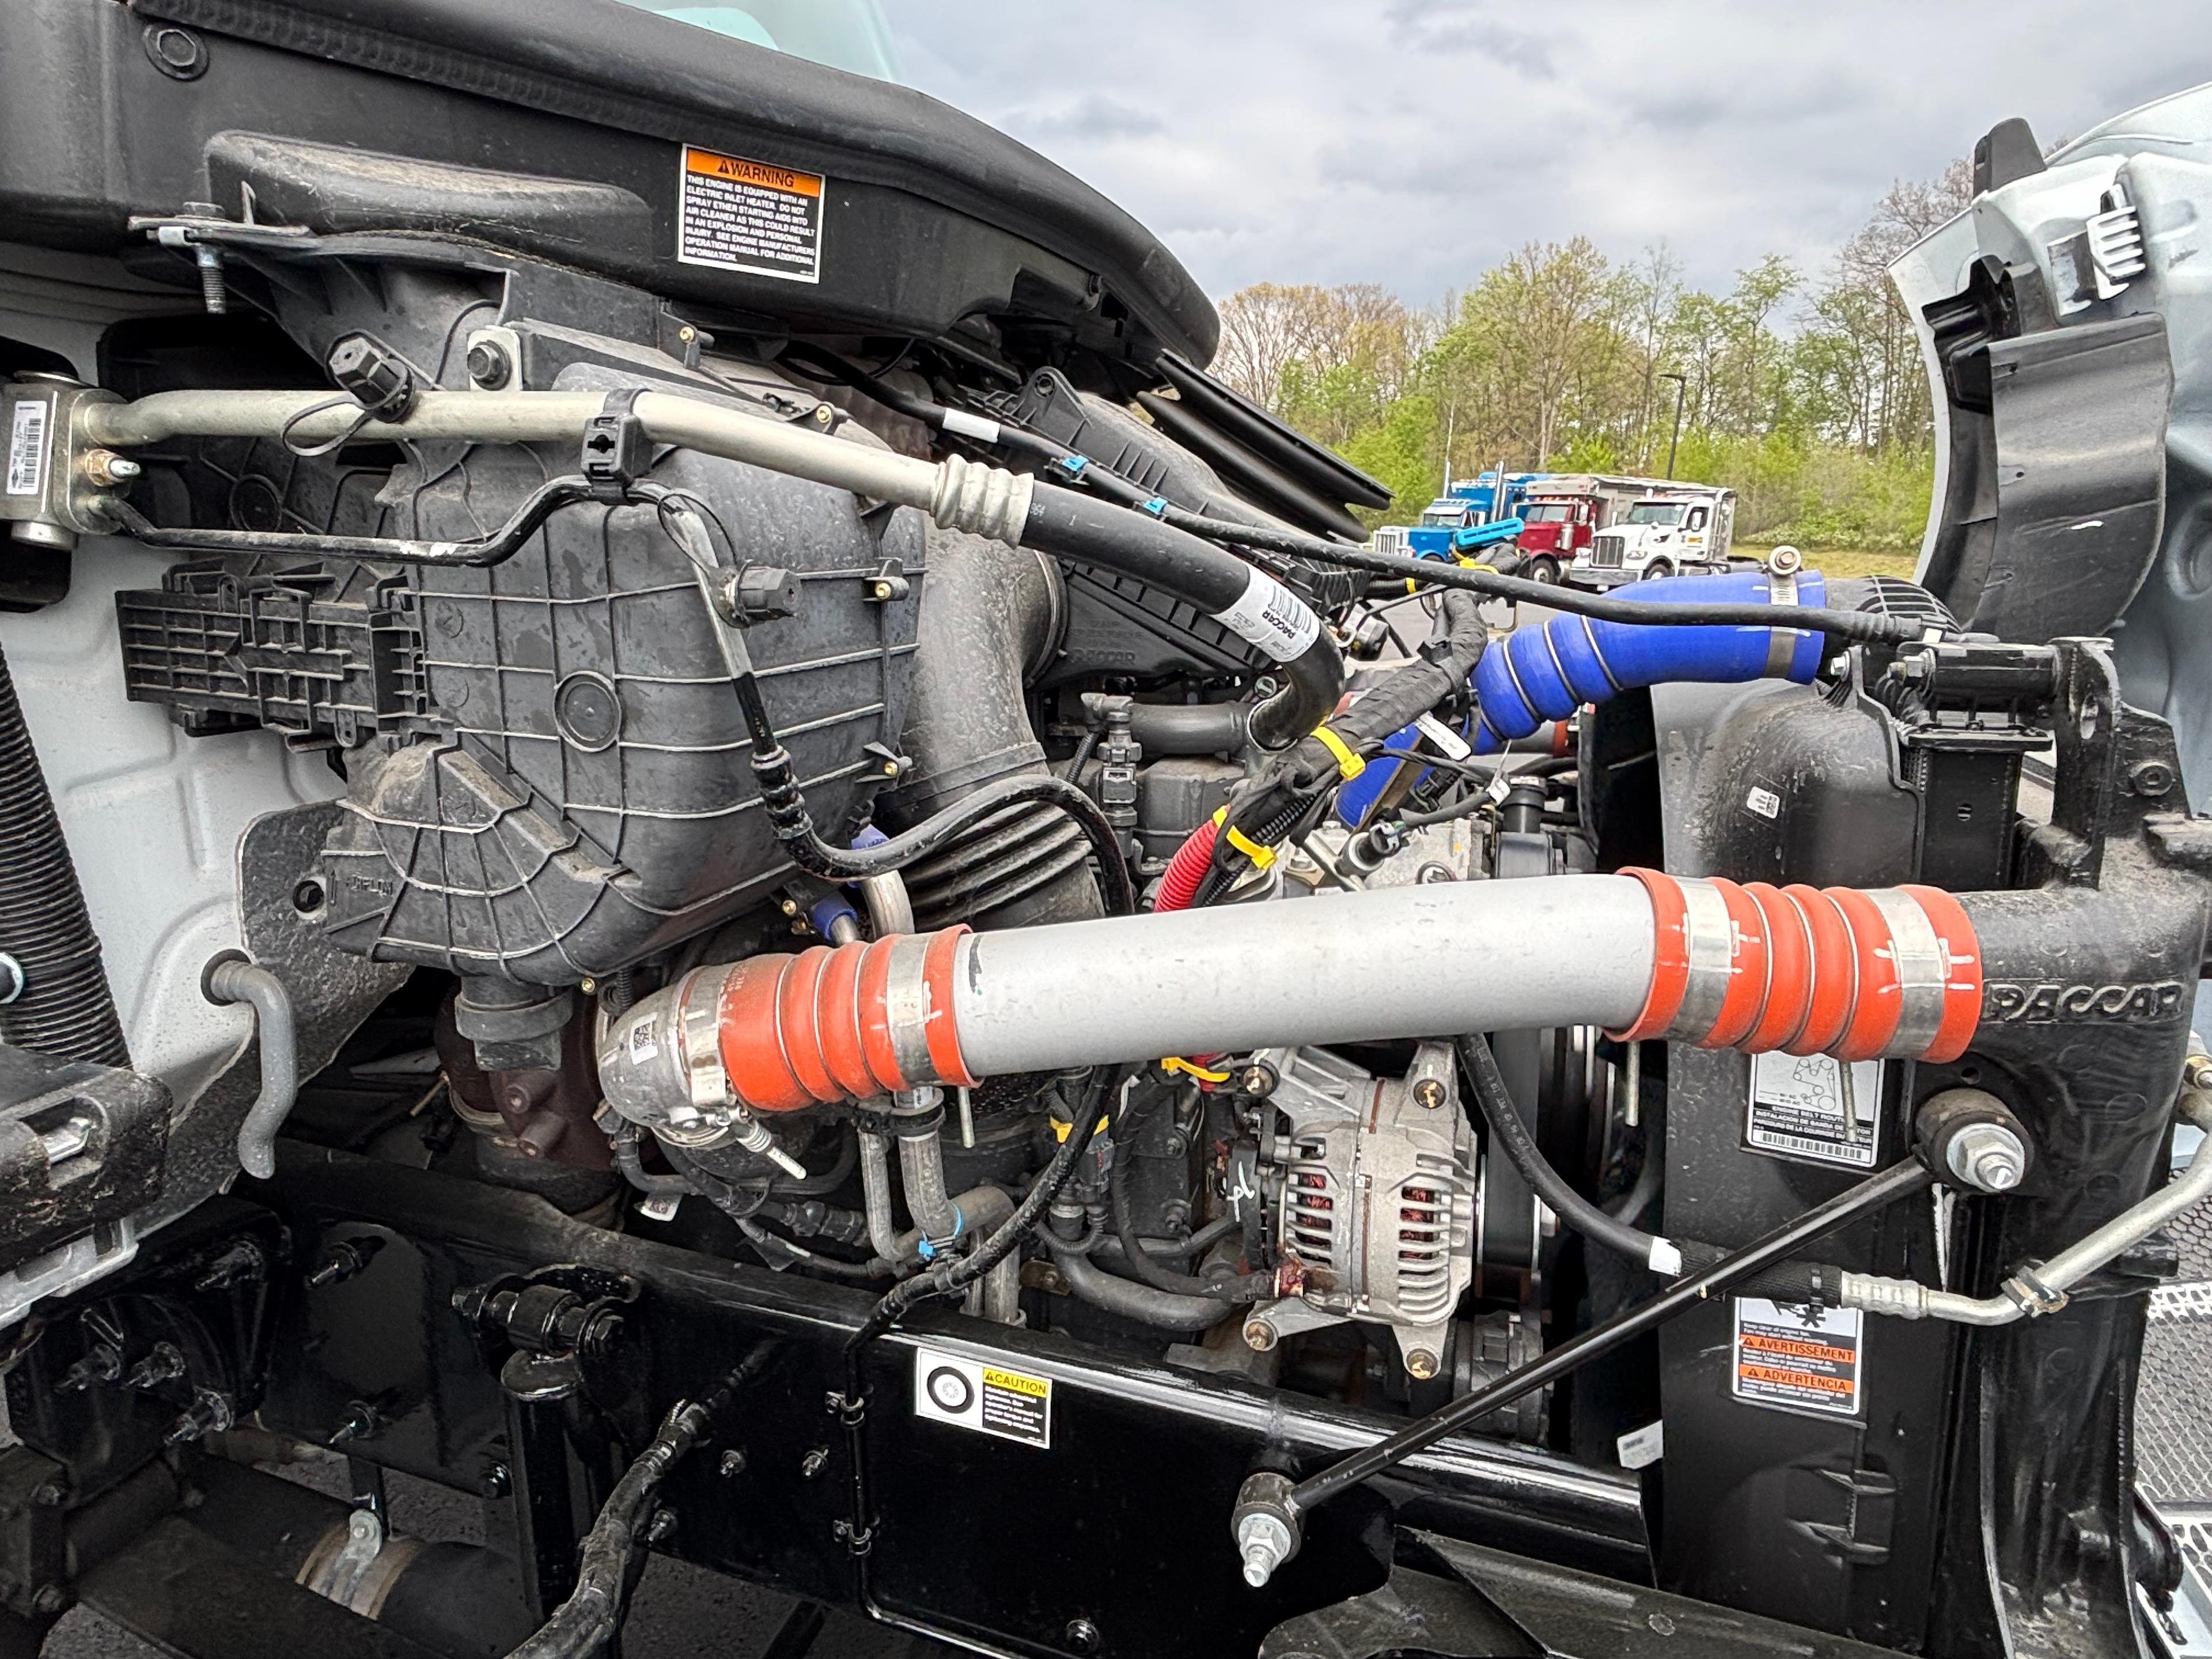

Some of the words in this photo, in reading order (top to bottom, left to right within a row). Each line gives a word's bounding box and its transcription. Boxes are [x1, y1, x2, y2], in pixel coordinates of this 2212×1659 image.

[687, 175, 704, 185] THIS
[729, 162, 794, 188] WARNING
[686, 195, 711, 208] SPRAY
[713, 200, 737, 212] ETHER
[738, 205, 774, 219] STARTING
[687, 185, 723, 199] ELECTRIC
[779, 203, 790, 212] DO
[686, 206, 699, 215] AIR
[700, 208, 735, 222] CLEANER
[736, 215, 747, 224] AS
[748, 217, 763, 228] THIS
[764, 220, 789, 232] COULD
[695, 218, 705, 226] AN
[707, 220, 748, 234] EXPLOSION
[685, 236, 728, 250] OPERATION
[760, 249, 774, 258] FOR
[716, 232, 730, 241] SEE
[1262, 609, 1296, 639] PACCAR
[1983, 983, 2185, 1021] PACCAR
[1759, 1338, 1853, 1361] AVERTISSEMENT
[995, 1373, 1046, 1395] CAUTION
[1763, 1369, 1847, 1391] ADVERTENCIA
